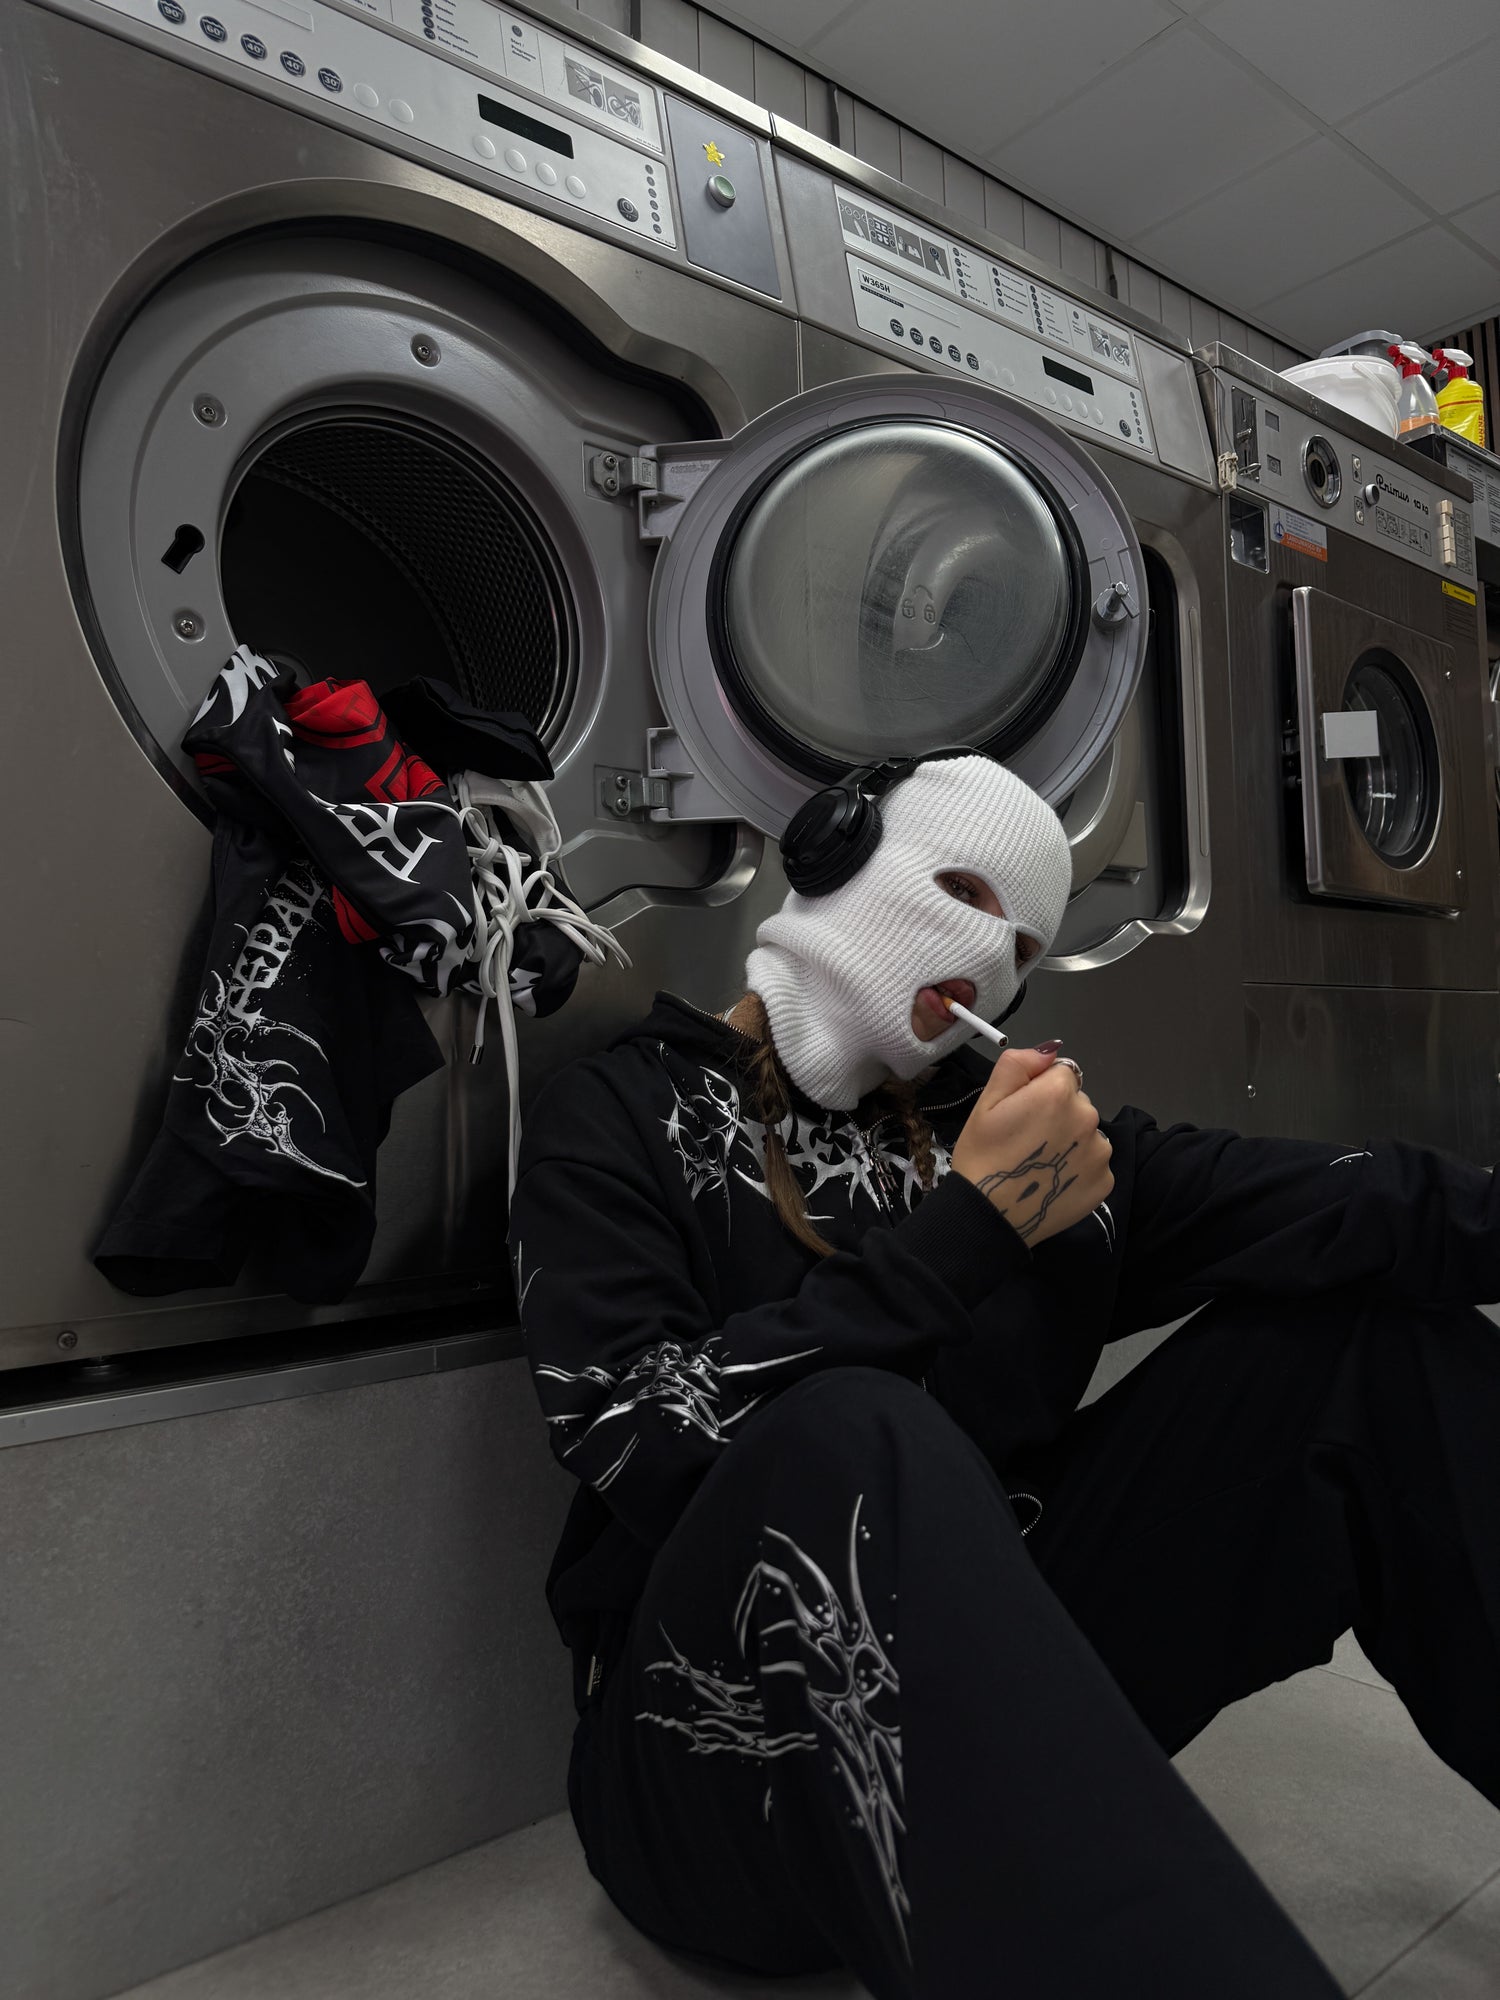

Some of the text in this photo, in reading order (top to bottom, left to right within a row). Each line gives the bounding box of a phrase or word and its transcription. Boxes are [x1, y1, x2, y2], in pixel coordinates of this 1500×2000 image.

[861, 273, 891, 294] W365H
[1375, 473, 1410, 503] Primus
[1421, 504, 1429, 515] kg
